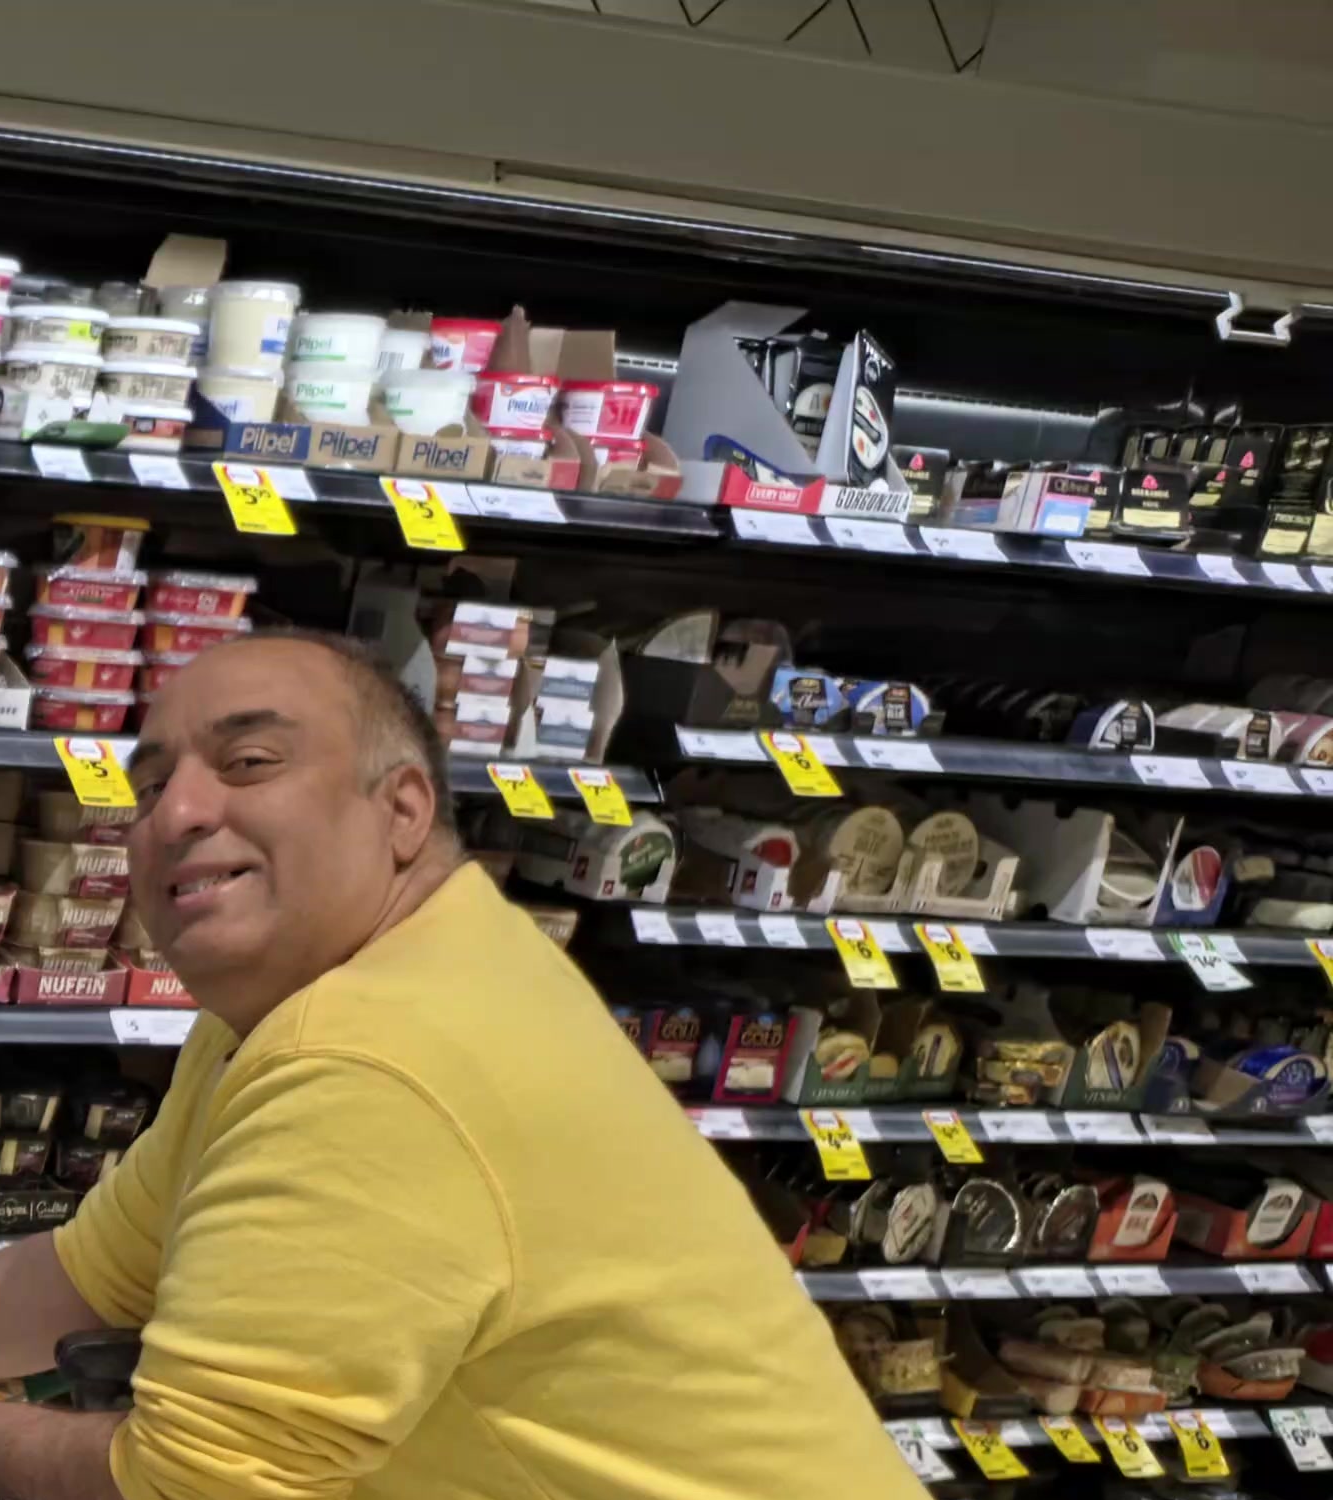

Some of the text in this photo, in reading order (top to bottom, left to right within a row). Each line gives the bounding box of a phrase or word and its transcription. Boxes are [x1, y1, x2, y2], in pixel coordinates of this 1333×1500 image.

[240, 426, 298, 454] Pilpel
[318, 430, 380, 457] Pilpel
[412, 439, 471, 467] Pilpel
